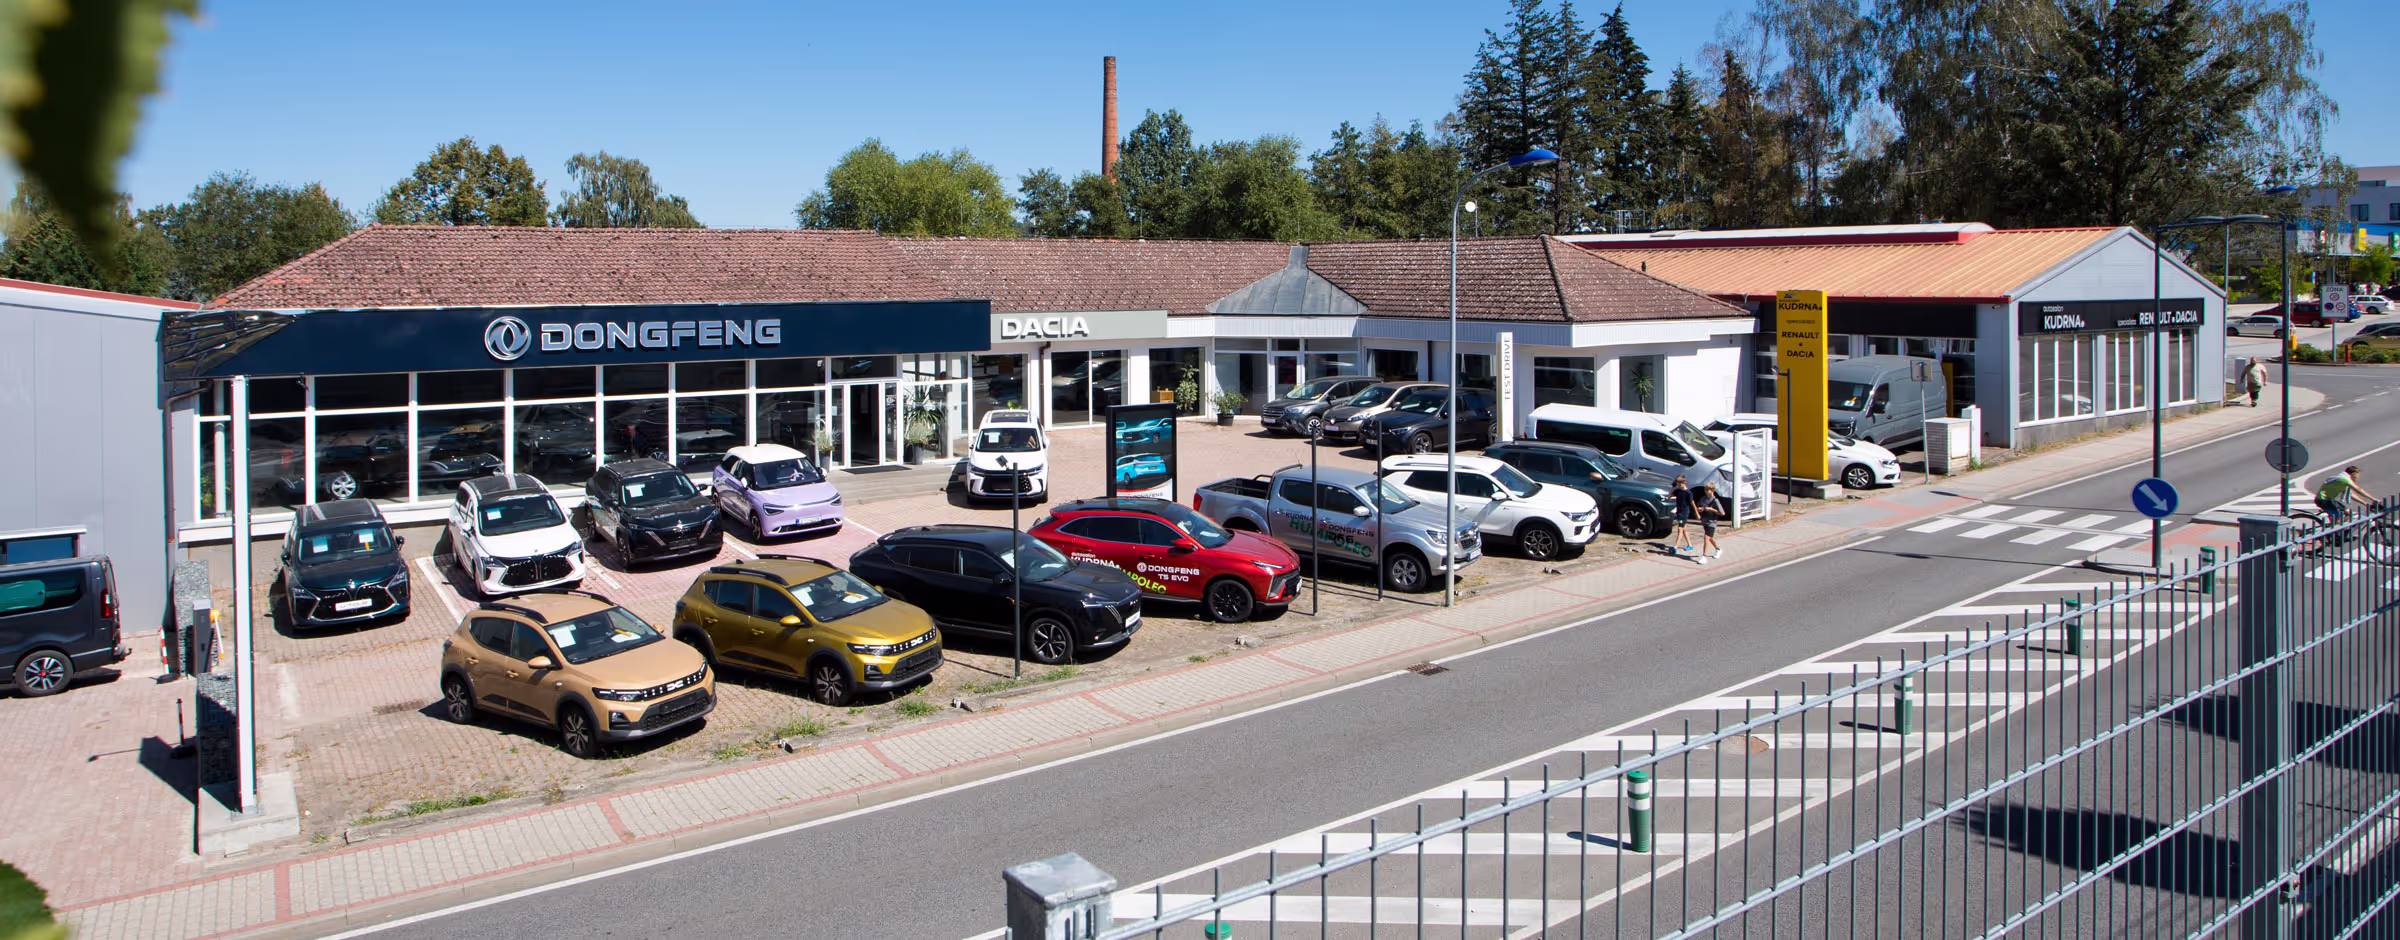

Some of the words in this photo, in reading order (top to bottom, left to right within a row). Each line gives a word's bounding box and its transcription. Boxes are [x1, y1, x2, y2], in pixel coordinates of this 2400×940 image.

[2139, 311, 2171, 325] RENULT
[2175, 310, 2198, 323] DACIA
[1001, 317, 1090, 339] DACIA
[541, 318, 781, 352] DONGFENG
[1781, 331, 1820, 339] RENAULT
[1786, 350, 1815, 358] DACIA
[1328, 524, 1374, 537] DONGFENG
[1148, 564, 1200, 575] DONGFENG
